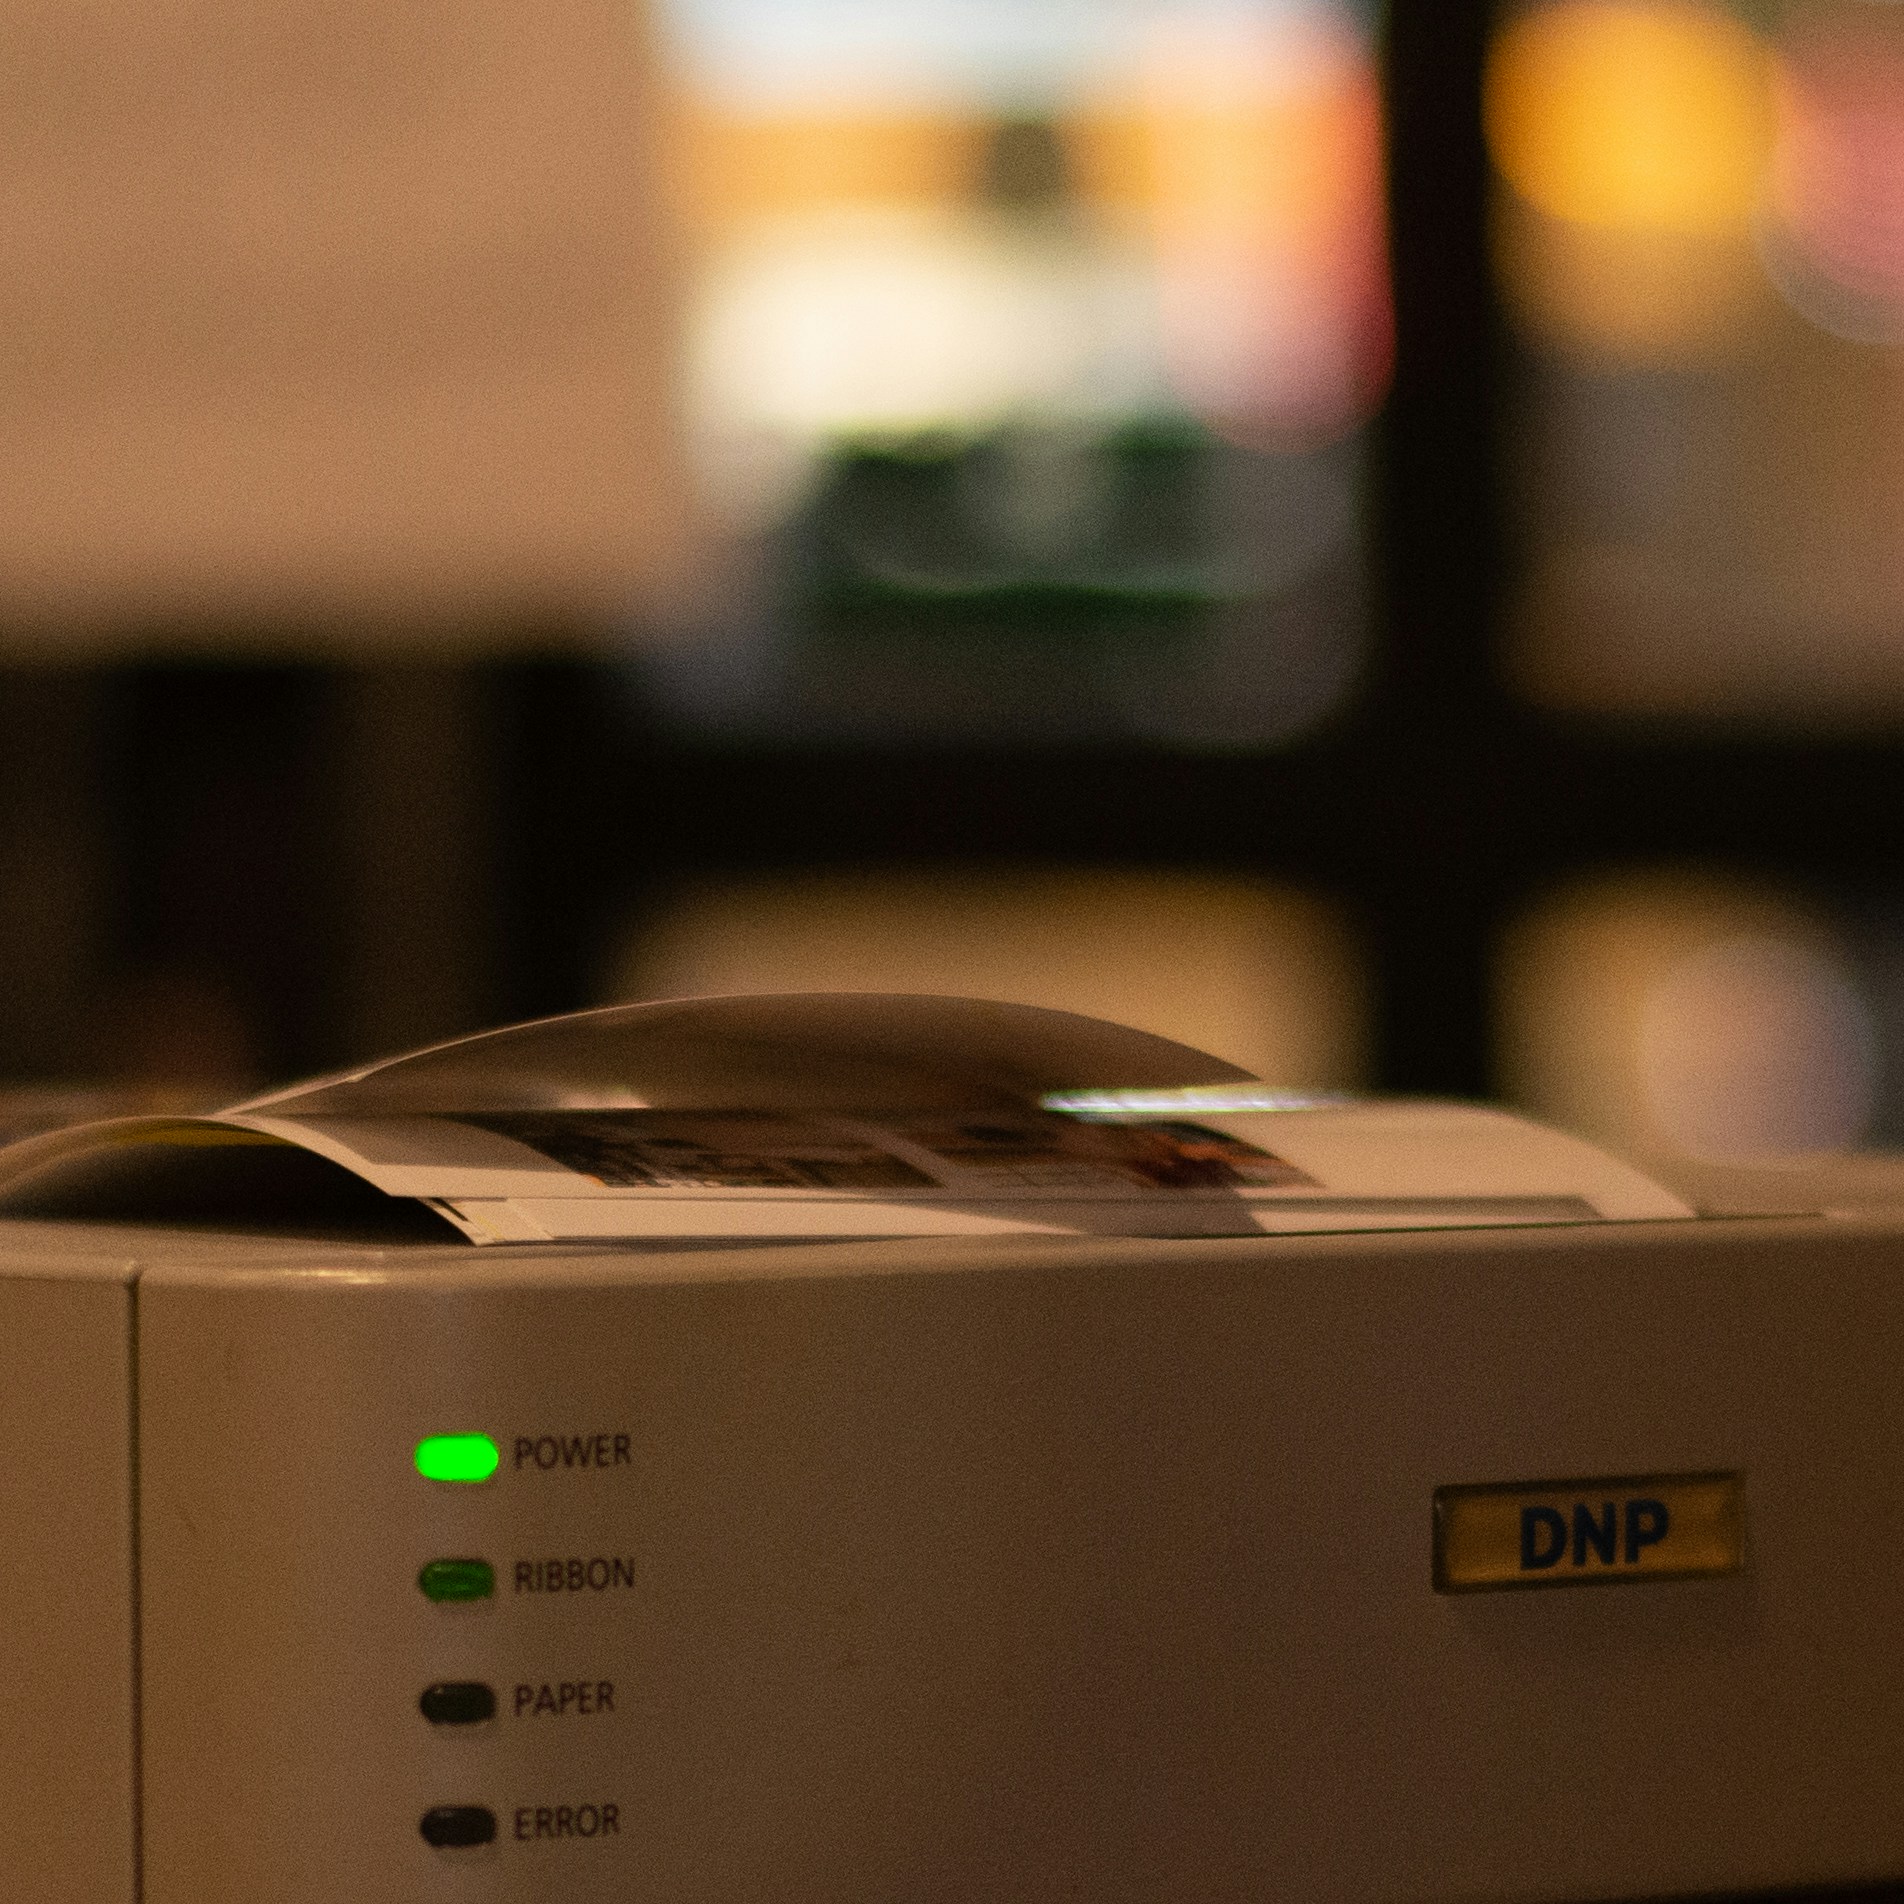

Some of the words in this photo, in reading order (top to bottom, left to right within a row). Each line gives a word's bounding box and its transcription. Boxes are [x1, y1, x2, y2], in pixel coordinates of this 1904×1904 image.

[513, 1434, 633, 1470] POWER
[1520, 1498, 1670, 1571] DNP
[513, 1557, 636, 1593] RIBBON
[513, 1681, 615, 1717] PAPER
[513, 1803, 622, 1841] ERROR
